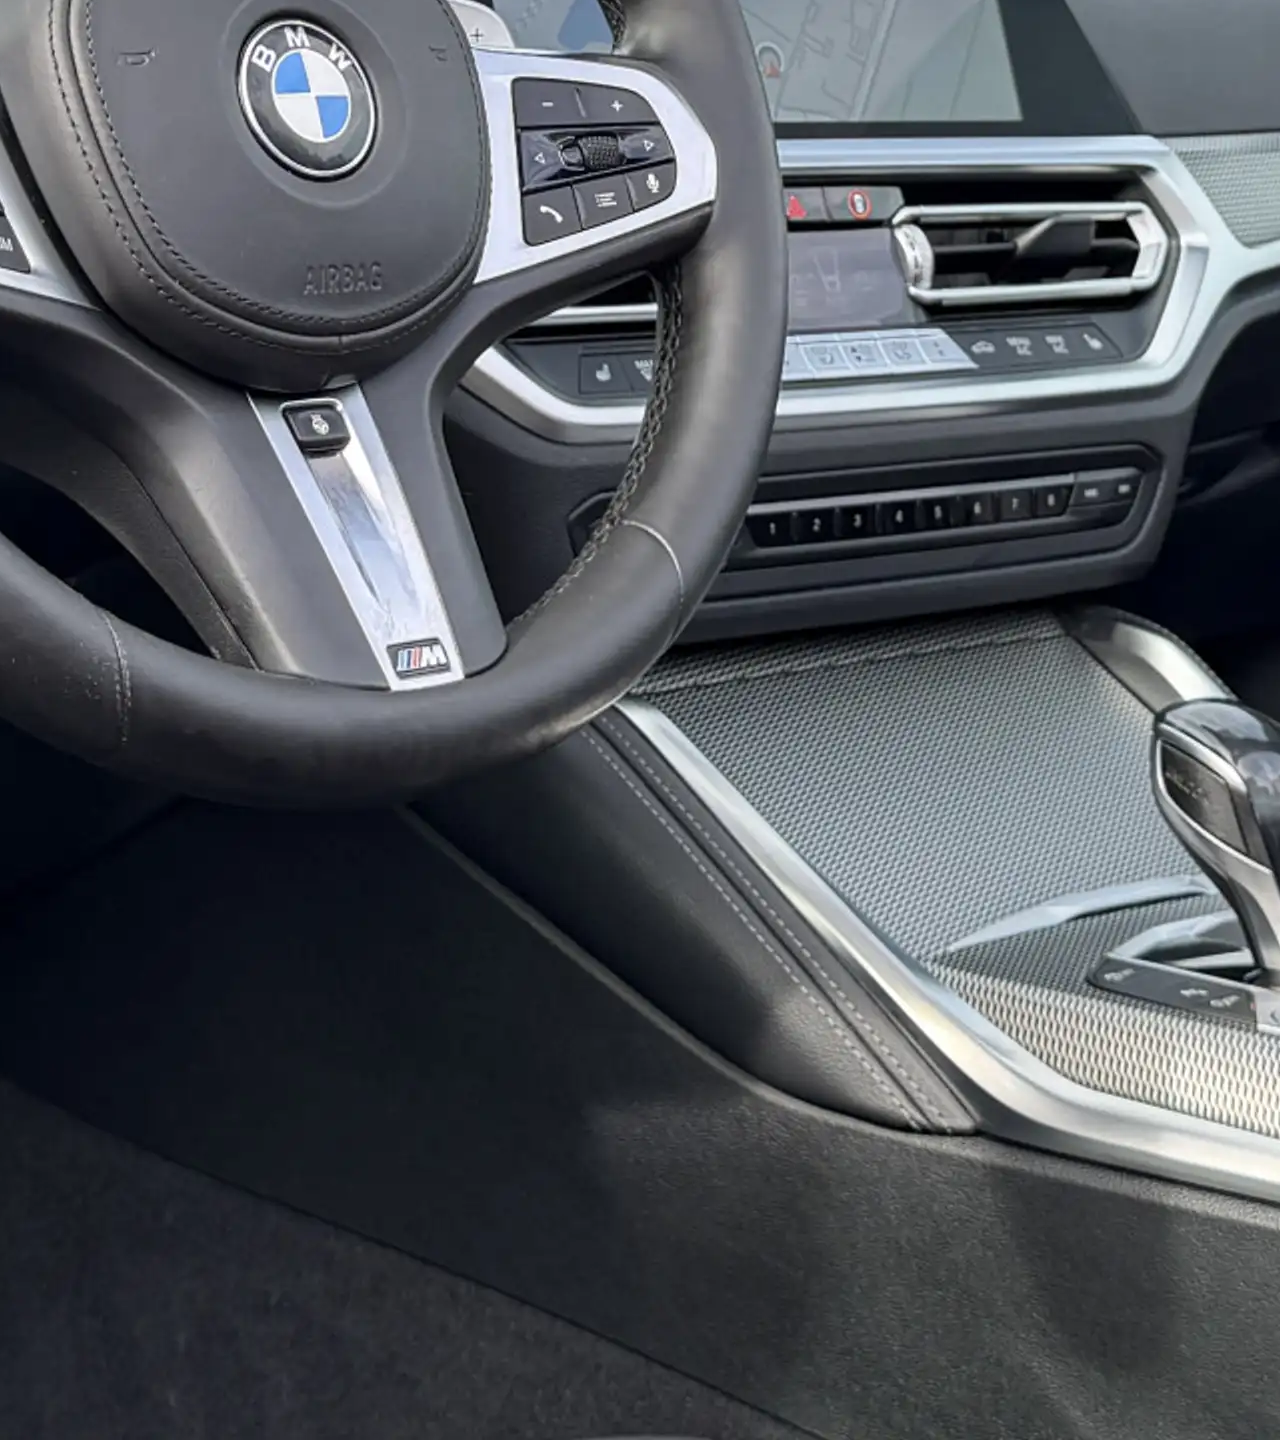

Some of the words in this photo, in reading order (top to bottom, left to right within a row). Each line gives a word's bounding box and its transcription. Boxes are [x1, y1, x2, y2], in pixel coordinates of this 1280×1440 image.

[251, 25, 352, 72] BMW
[303, 261, 384, 296] AIRBAG
[853, 513, 862, 528] 3
